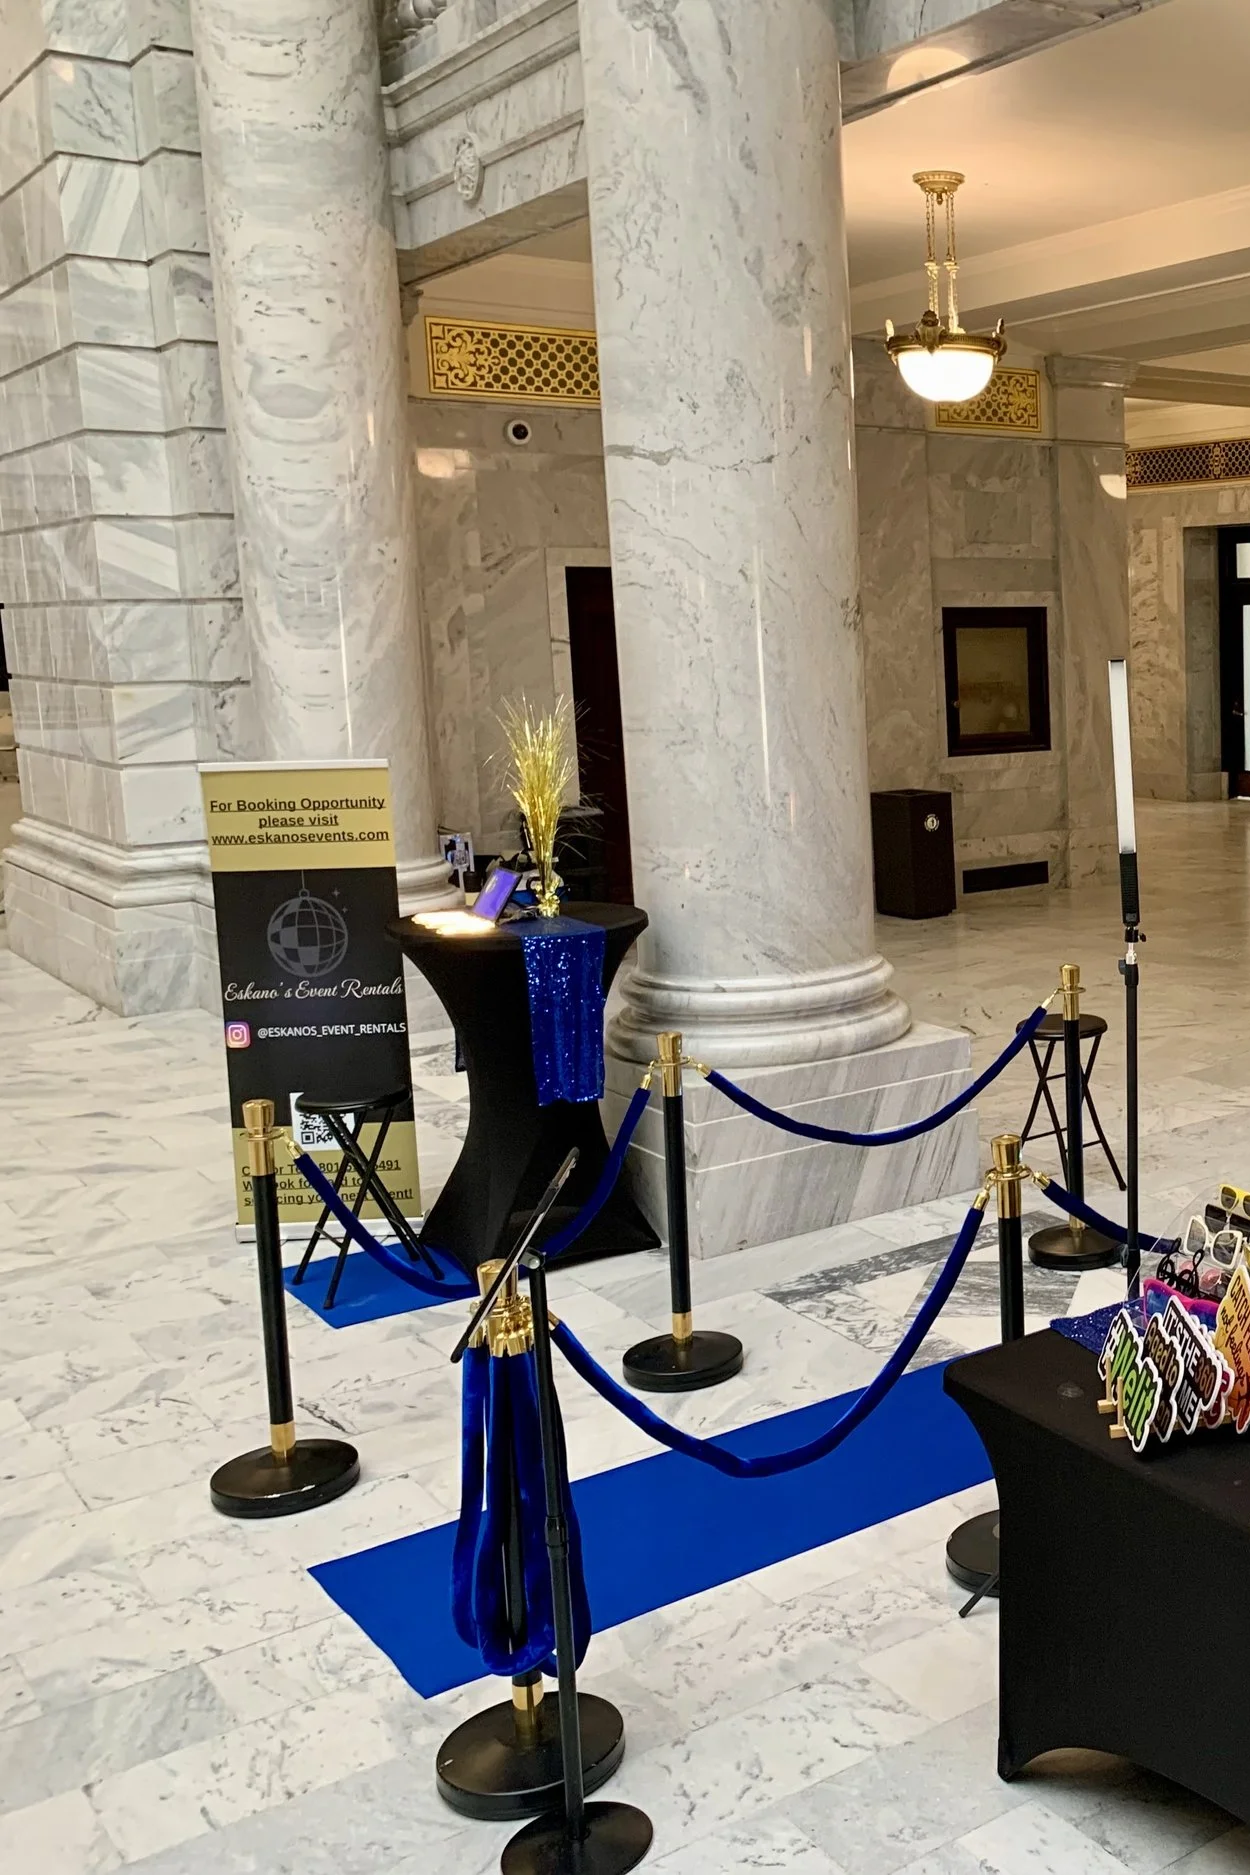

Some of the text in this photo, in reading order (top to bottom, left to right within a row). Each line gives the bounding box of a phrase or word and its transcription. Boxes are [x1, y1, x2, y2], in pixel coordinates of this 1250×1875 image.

[210, 796, 386, 813] For Booking Opportunity
[258, 814, 339, 829] please visit
[211, 830, 390, 845] www.eskanosevents.com
[294, 981, 338, 999] Event
[340, 976, 404, 999] Rentals
[257, 1023, 407, 1039] @ESKANOS_EVENT_RENTALS
[1220, 1306, 1235, 1334] not
[1164, 1305, 1183, 1344] IT'S
[1181, 1327, 1201, 1379] THE
[1194, 1357, 1217, 1400] 360
[1165, 1352, 1179, 1388] to
[1178, 1379, 1198, 1424] ME
